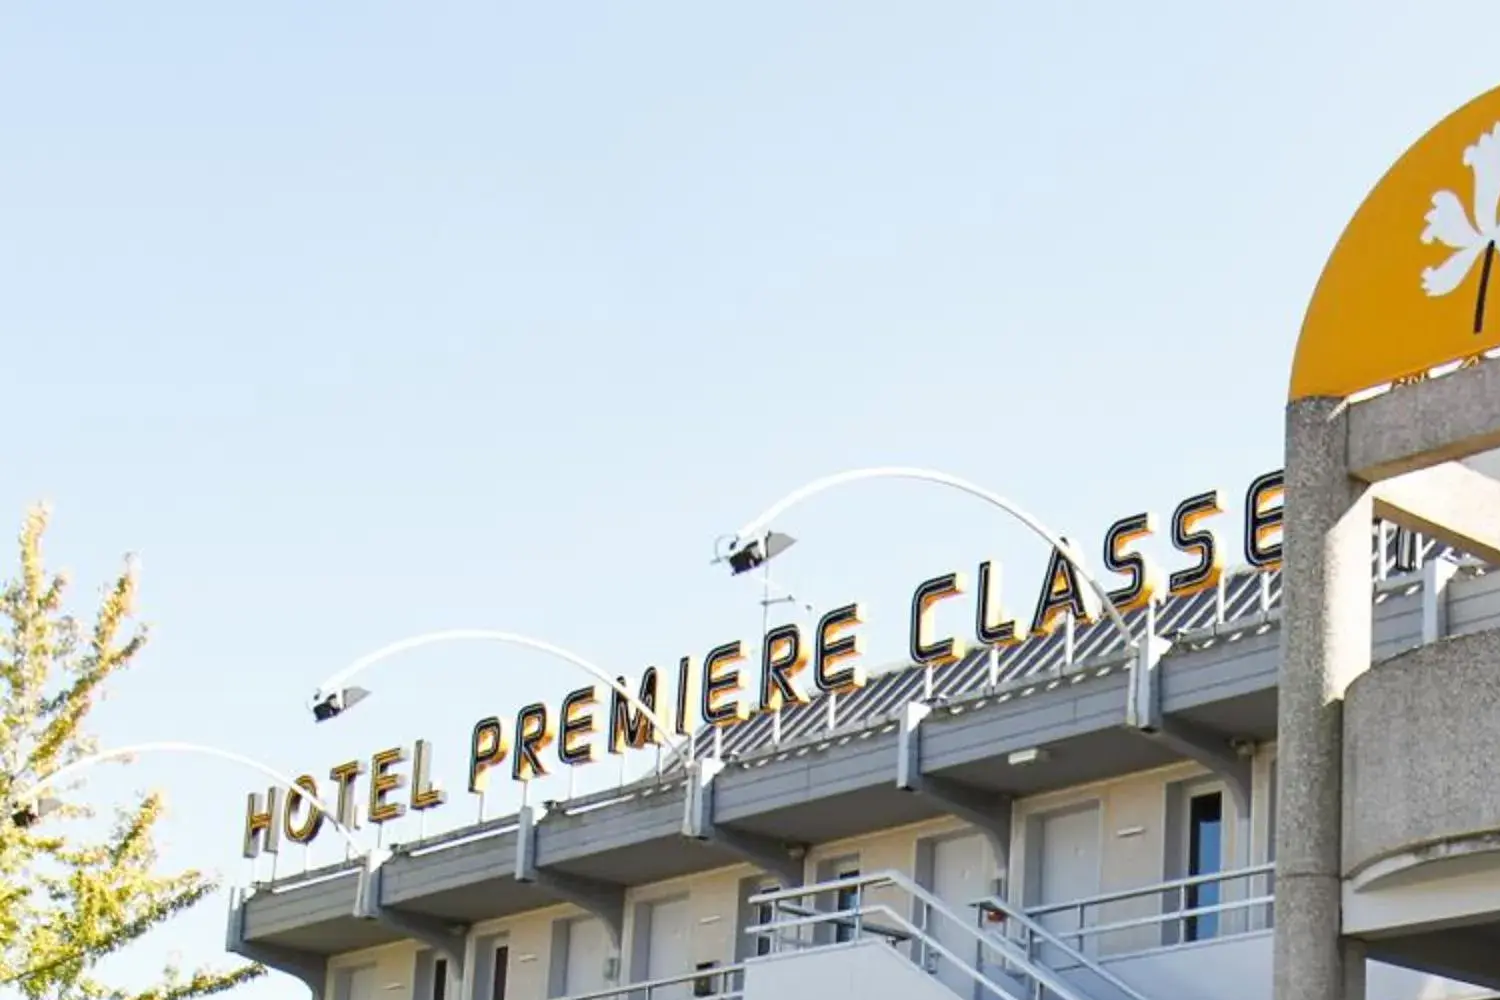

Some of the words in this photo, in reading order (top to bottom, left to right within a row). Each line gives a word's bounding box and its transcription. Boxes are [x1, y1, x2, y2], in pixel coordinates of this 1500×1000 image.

[243, 739, 446, 858] HOTEL
[467, 603, 867, 794] PREMIERE
[910, 469, 1285, 665] CLASSE
